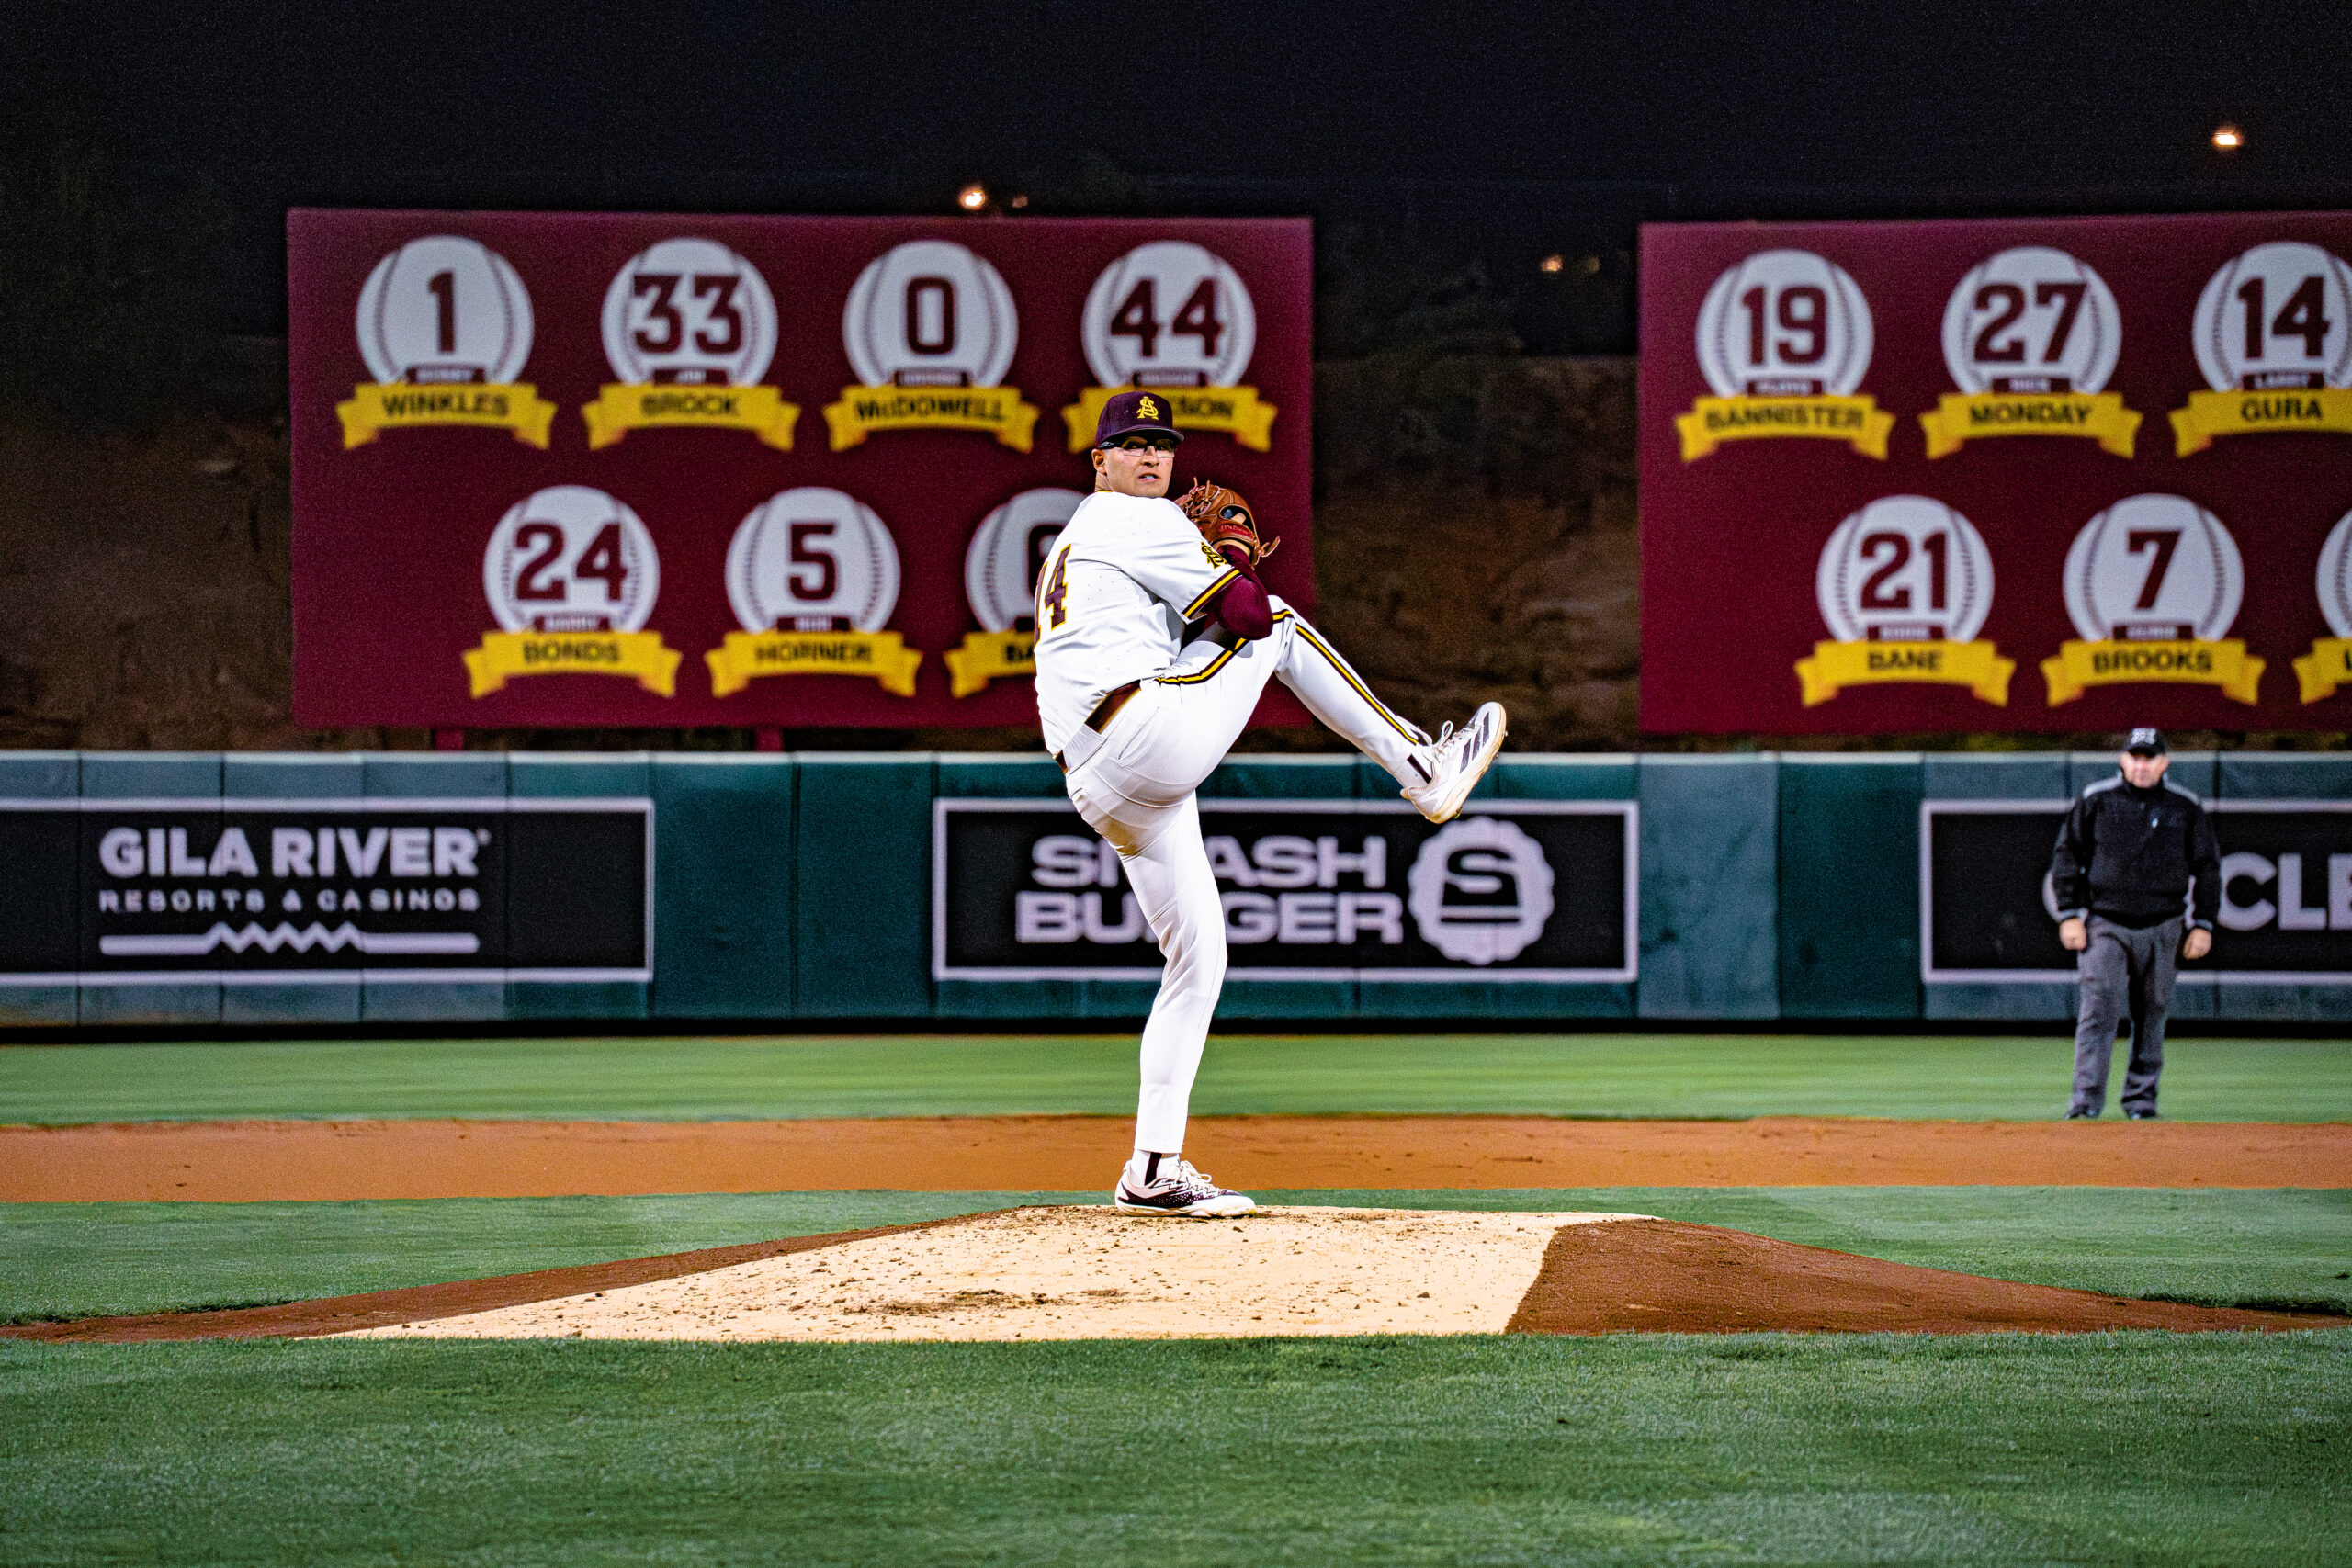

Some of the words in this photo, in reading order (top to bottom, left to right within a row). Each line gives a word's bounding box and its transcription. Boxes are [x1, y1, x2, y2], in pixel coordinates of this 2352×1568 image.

[429, 272, 456, 355] 1
[633, 273, 742, 355] 33
[905, 276, 956, 355] 0
[1110, 277, 1224, 357] 44
[1742, 285, 1827, 366] 19
[1973, 282, 2087, 362] 27
[2237, 276, 2331, 358] 14
[381, 393, 510, 417] WINKLES
[641, 393, 740, 417] BROCK
[1705, 404, 1865, 432] BANNISTER
[1970, 403, 2094, 424] MONDAY
[2242, 396, 2323, 423] GURA
[515, 522, 628, 601] 24
[788, 523, 838, 601] 5
[1860, 531, 1948, 611] 21
[2127, 530, 2182, 611] 7
[522, 639, 622, 662] BONDS
[755, 641, 872, 663] HORNER
[1868, 649, 1944, 671] BANE
[2093, 649, 2213, 672] BROOKS
[98, 827, 260, 878] GILA
[1031, 834, 1387, 888] SASH
[98, 888, 266, 912] RESORTS
[316, 887, 480, 912] CASINOS
[1015, 890, 1404, 944] BUGER
